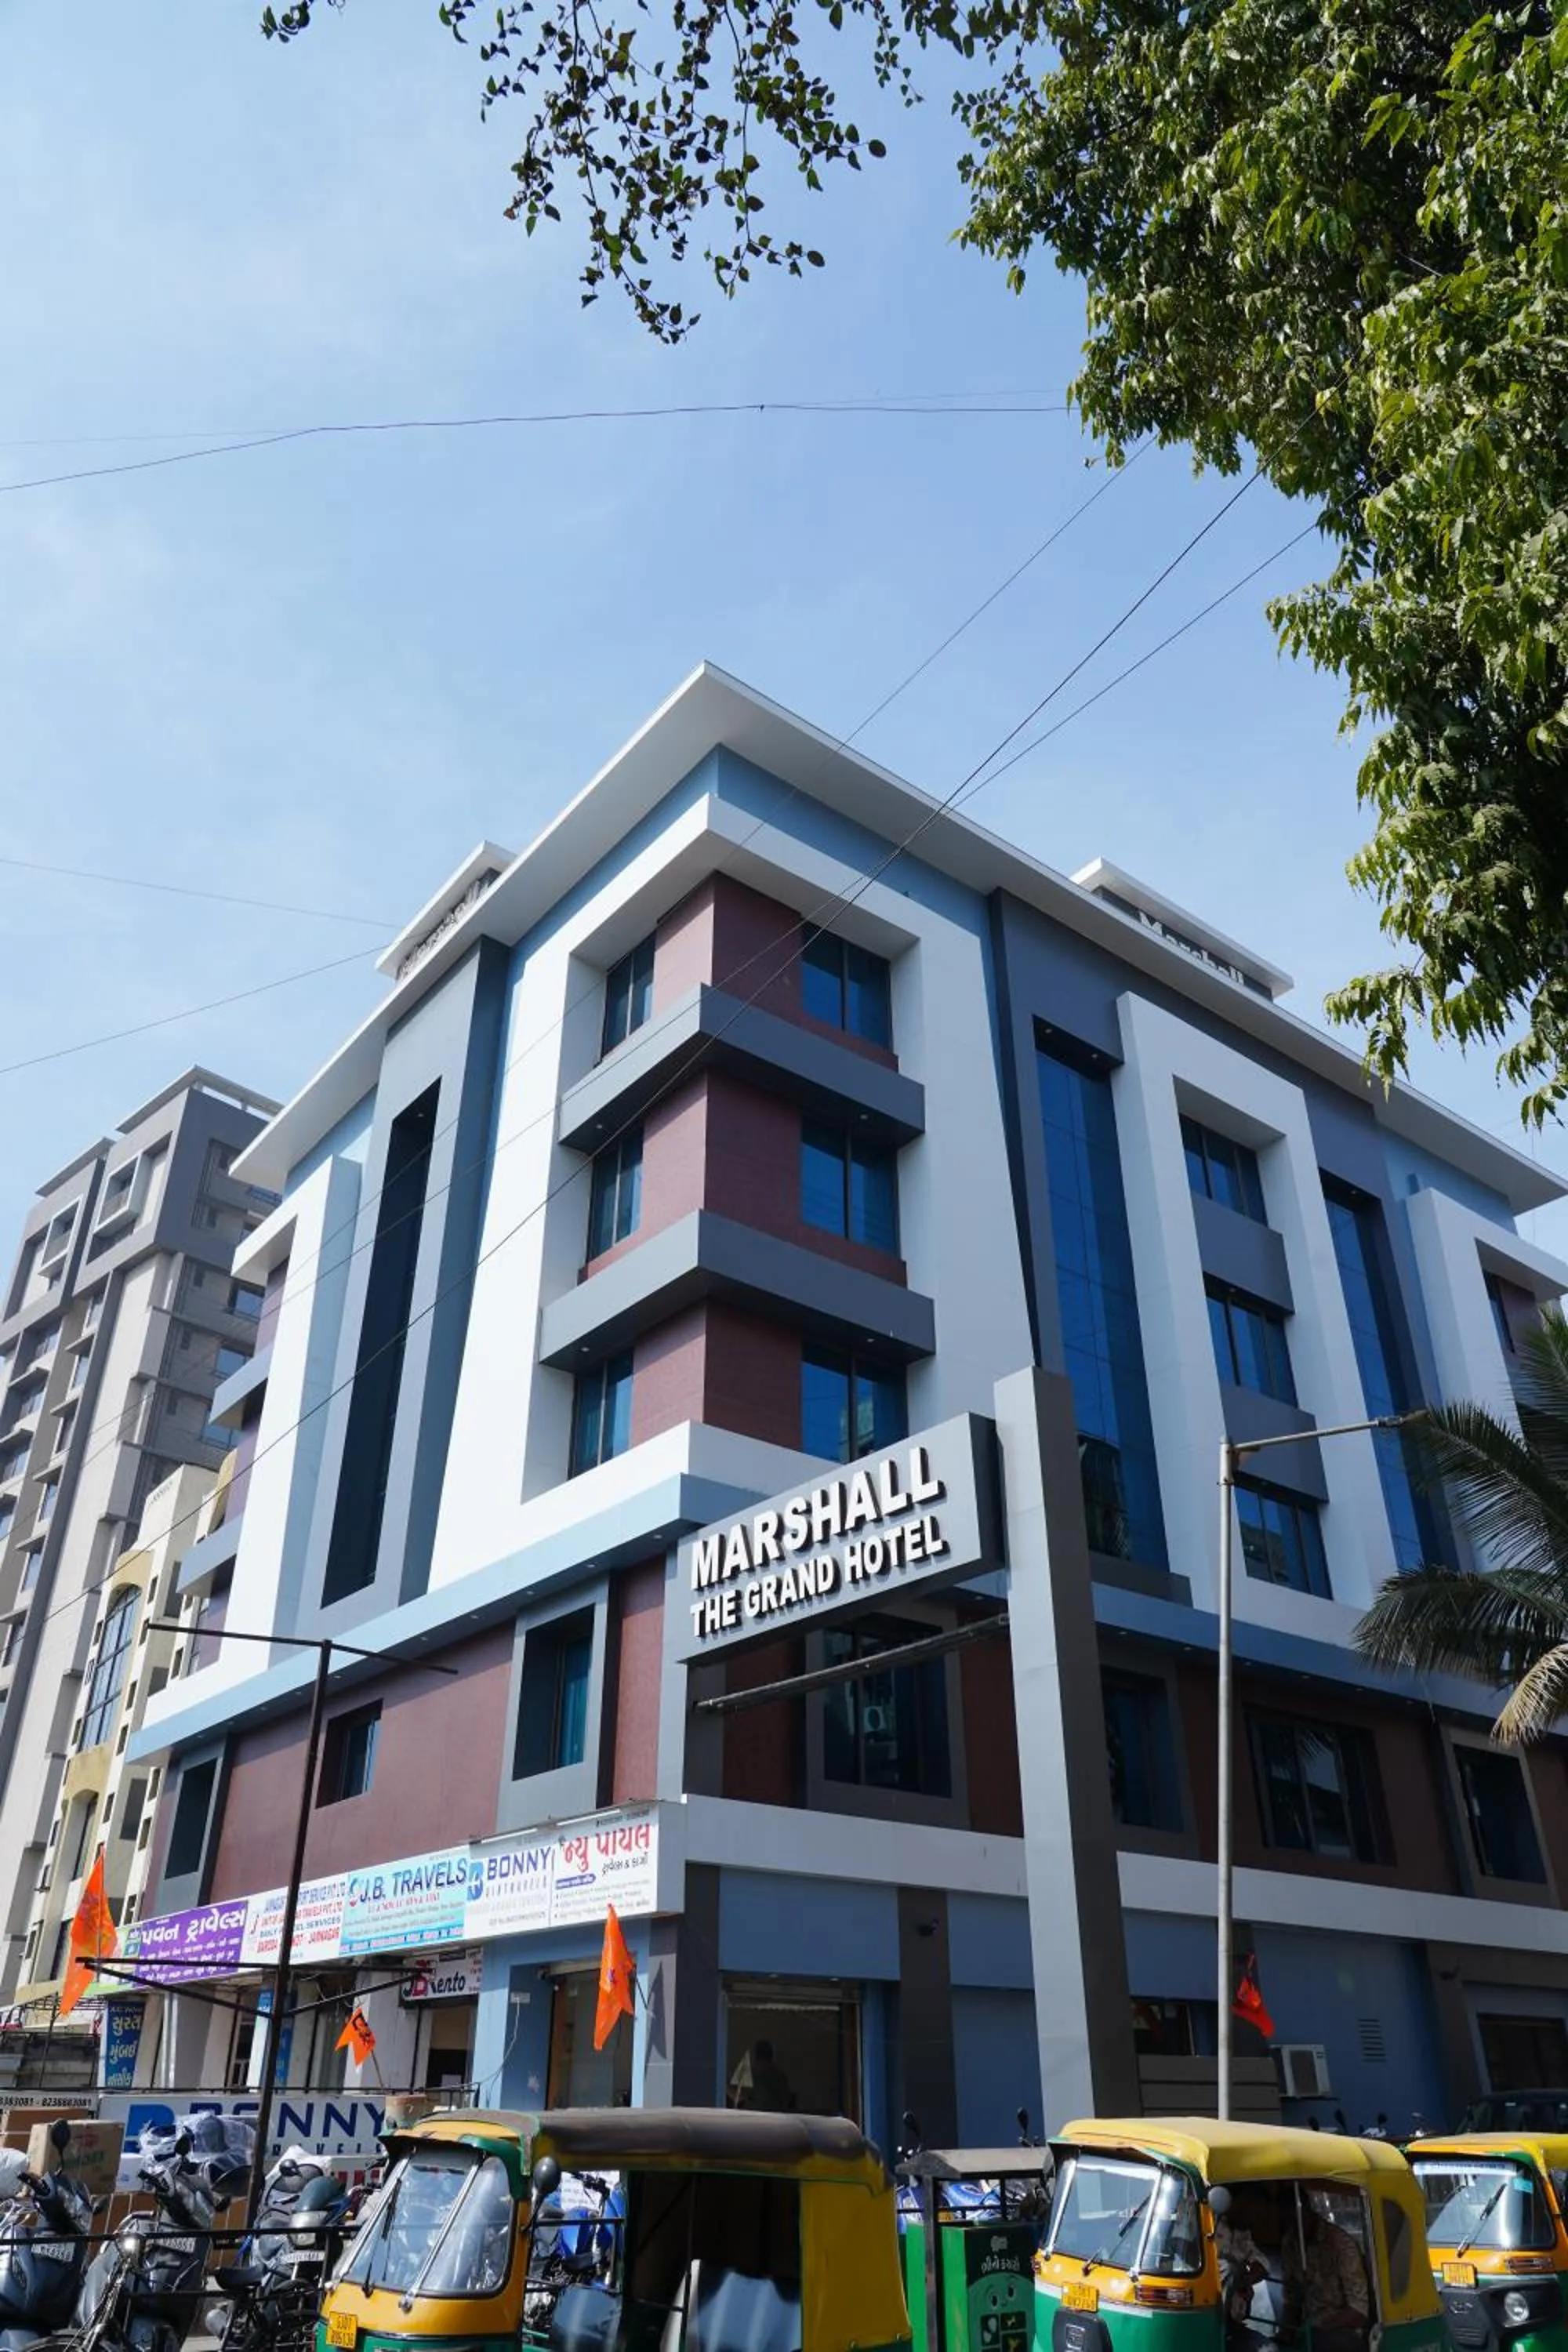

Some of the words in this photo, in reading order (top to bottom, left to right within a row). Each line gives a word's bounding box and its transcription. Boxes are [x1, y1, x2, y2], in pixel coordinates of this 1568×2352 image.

[691, 1446, 945, 1591] MARSHALL
[690, 1589, 739, 1638] THE
[746, 1555, 838, 1618] GRAND
[846, 1515, 948, 1584] HOTEL
[595, 1823, 652, 1857] પાયલ
[360, 1876, 387, 1904] J.B.
[392, 1857, 468, 1896] TRAVELS
[487, 1846, 551, 1881] BONNY
[142, 1924, 180, 1945] પવન
[186, 1908, 246, 1943] ટ્રાવેલ્સ
[190, 2102, 386, 2138] NNY
